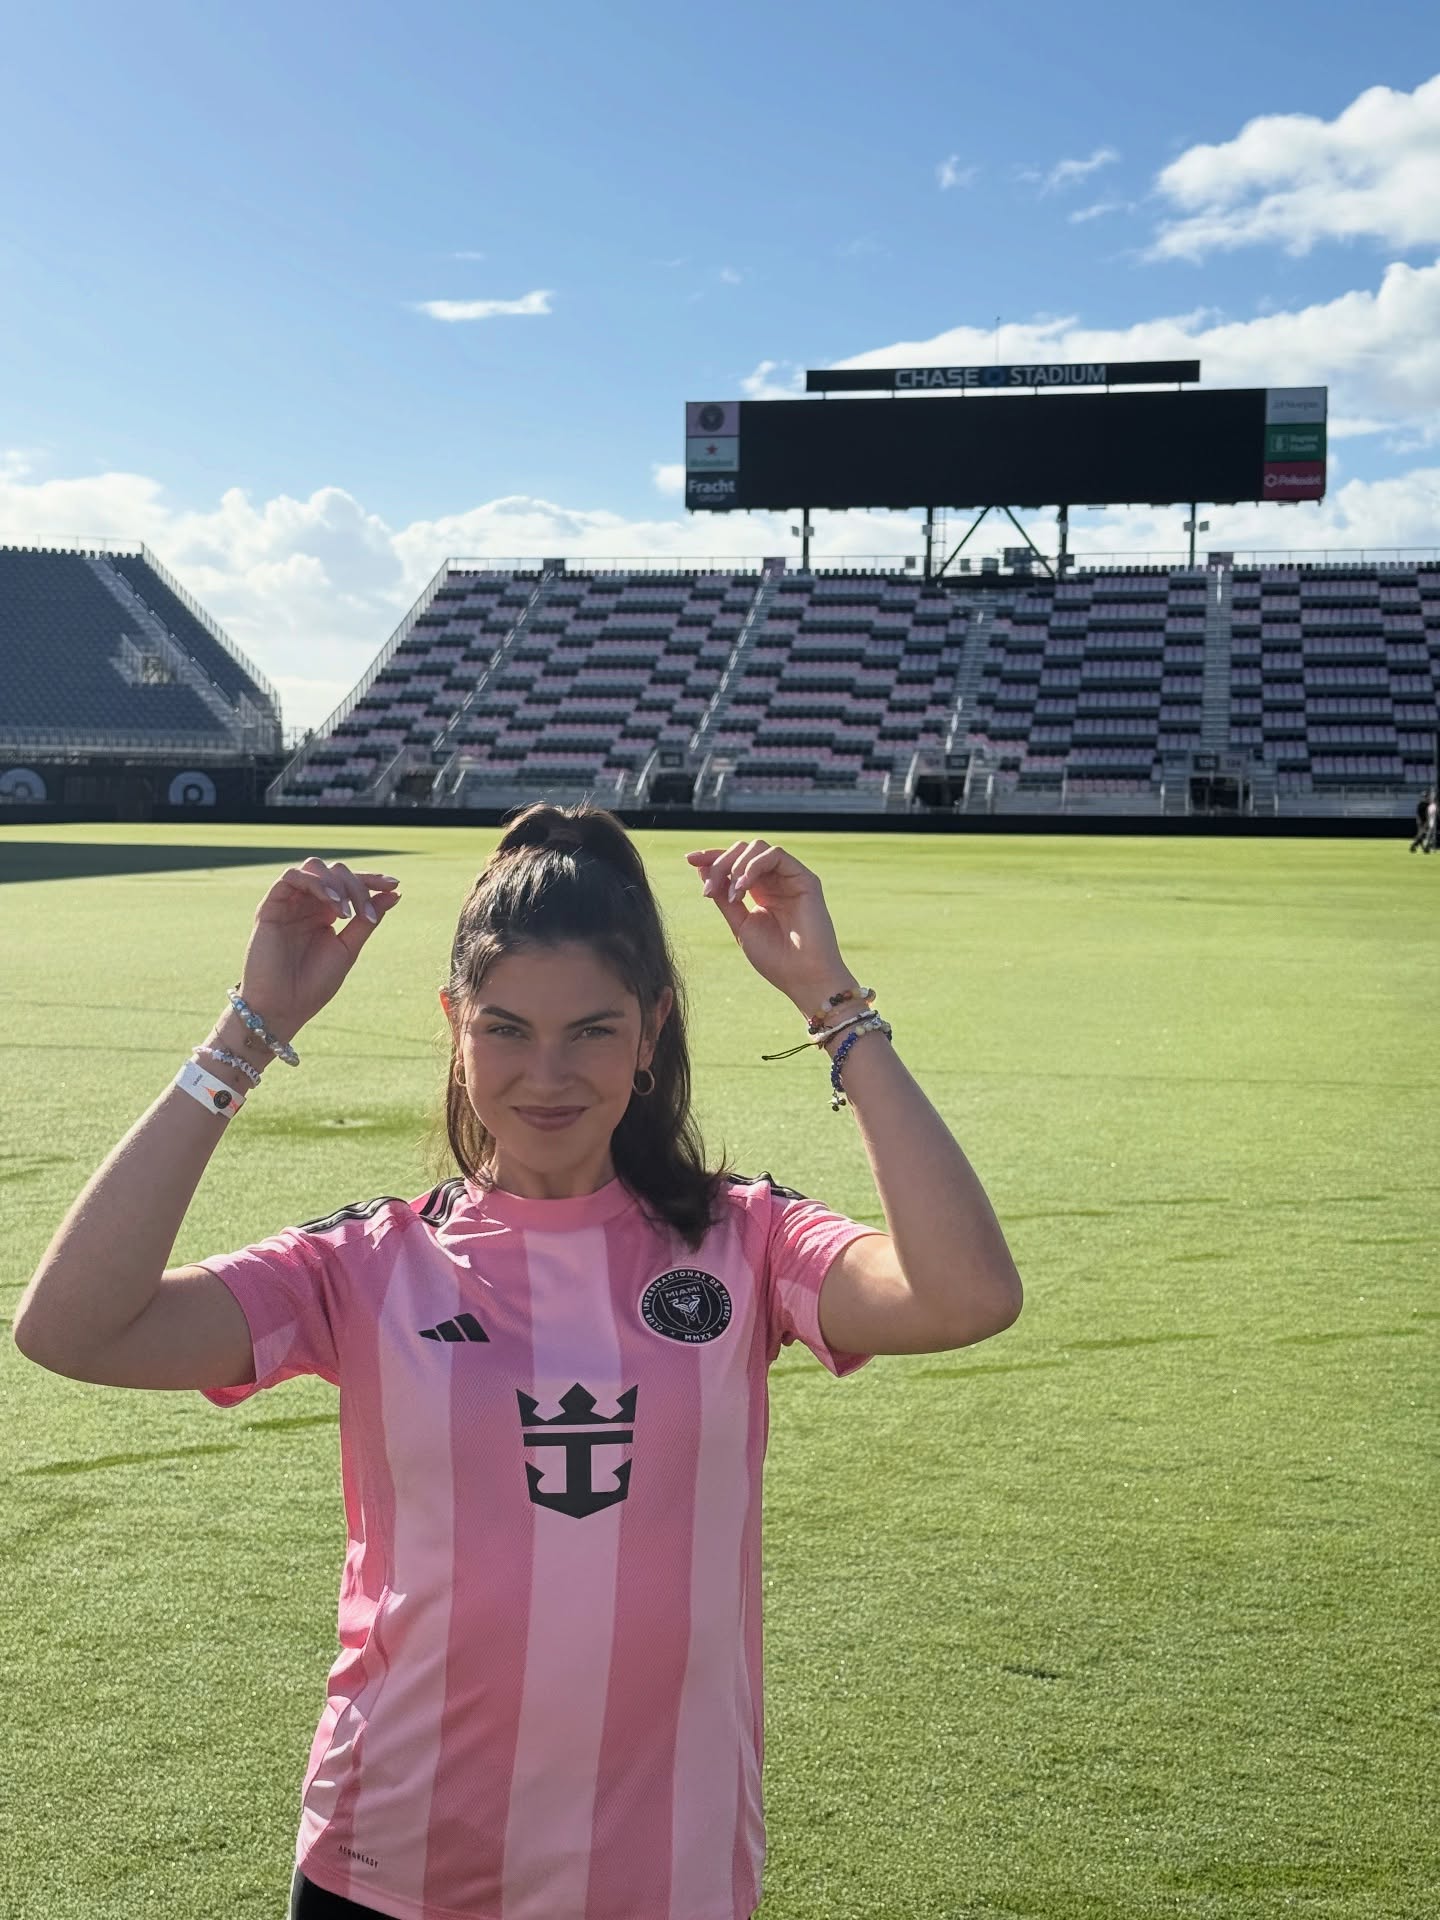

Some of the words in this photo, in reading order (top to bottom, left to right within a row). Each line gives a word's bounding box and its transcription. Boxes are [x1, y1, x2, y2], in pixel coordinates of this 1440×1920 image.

[895, 369, 979, 387] CHASE
[1010, 365, 1107, 385] STADIUM
[688, 479, 736, 493] Fracht
[709, 1278, 721, 1288] DE
[643, 1271, 706, 1311] INTERNACIONAL
[665, 1285, 701, 1299] MIAMI
[645, 1313, 664, 1331] CLUB
[684, 1331, 713, 1341] MMXX
